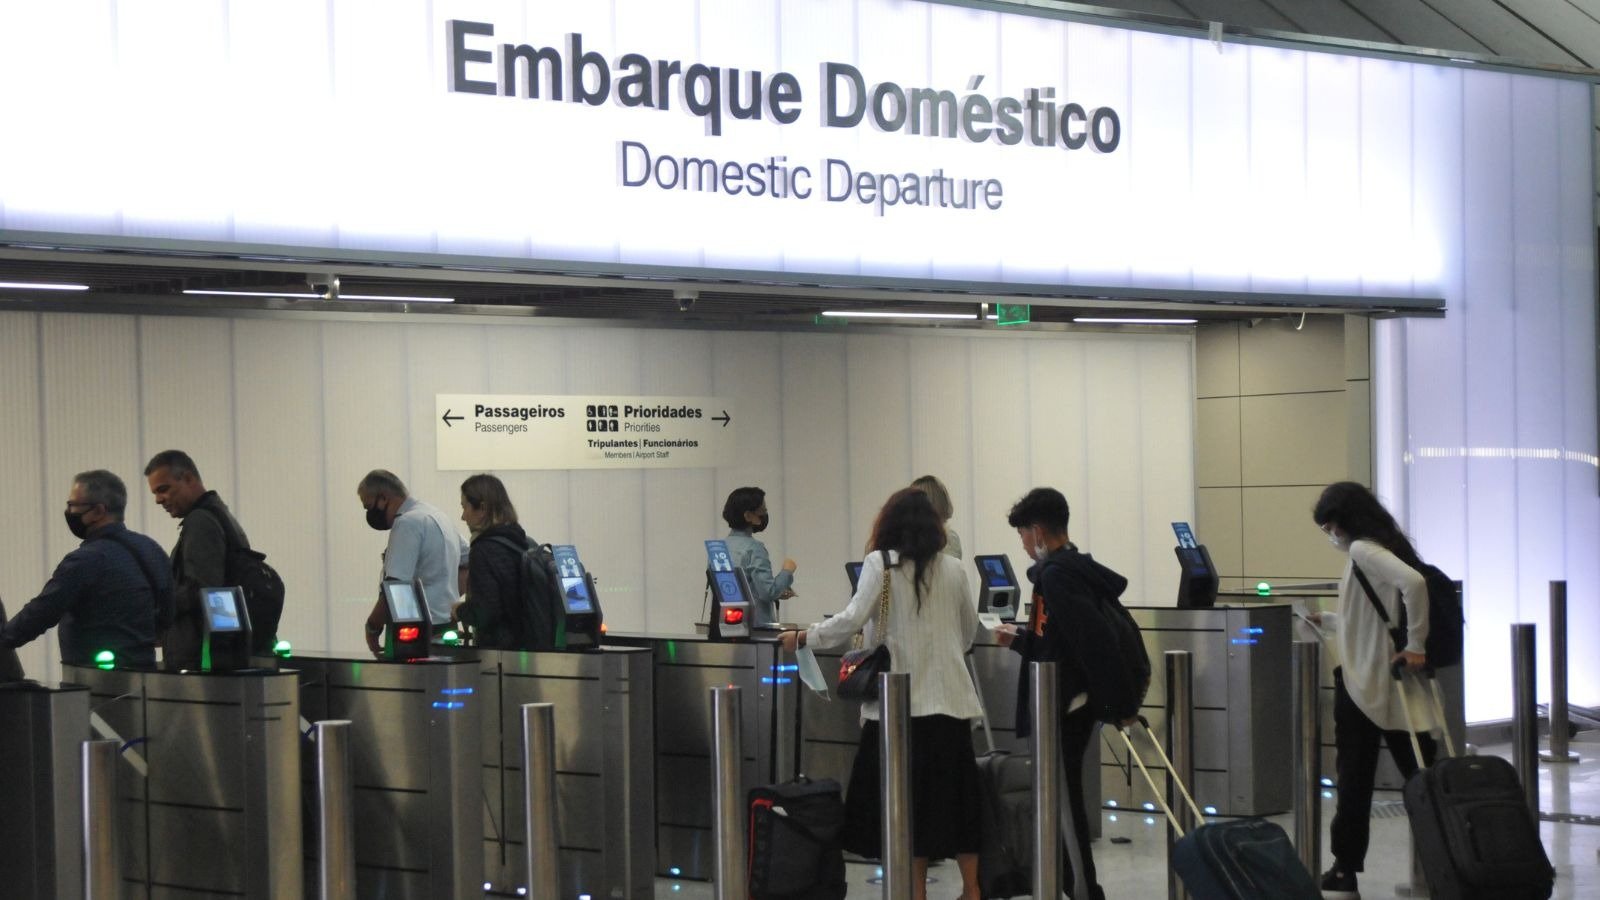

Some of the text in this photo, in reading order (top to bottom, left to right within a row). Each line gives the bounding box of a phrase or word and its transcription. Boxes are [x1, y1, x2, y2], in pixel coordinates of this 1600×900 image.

[448, 19, 1122, 154] Embarque Doméstico
[618, 140, 1004, 218] Domestic Departure
[474, 403, 566, 420] Passageiros
[624, 404, 703, 419] Prioridades
[474, 421, 529, 434] Passengers
[624, 422, 661, 433] Priorities
[587, 438, 699, 450] Tripulantes Funcionários
[604, 450, 670, 460] Members Airport Staff
